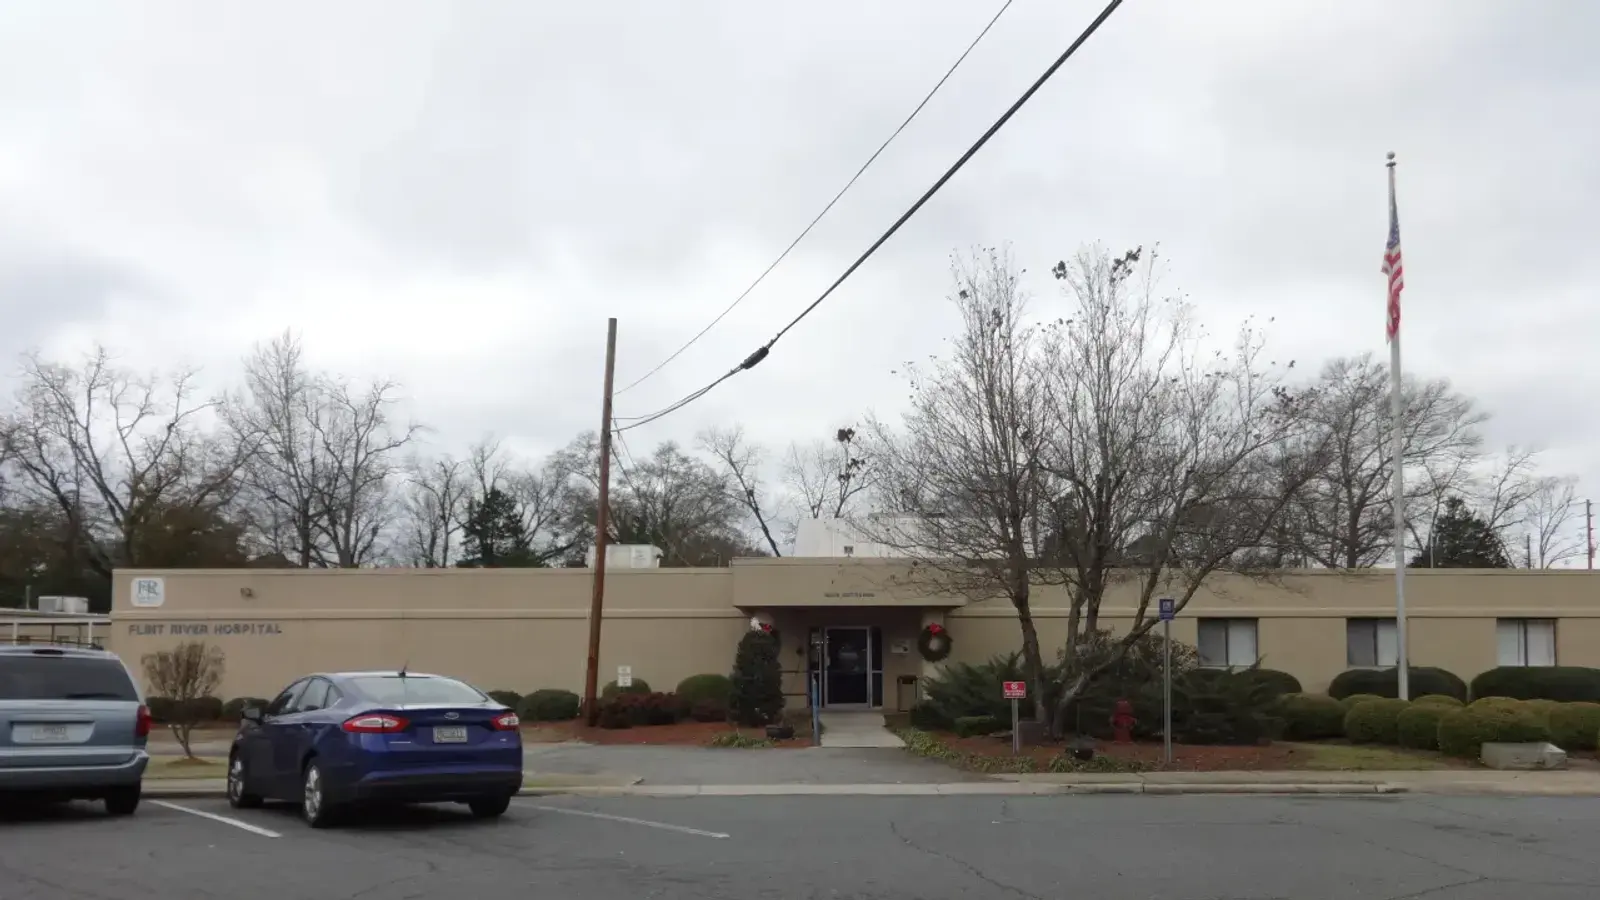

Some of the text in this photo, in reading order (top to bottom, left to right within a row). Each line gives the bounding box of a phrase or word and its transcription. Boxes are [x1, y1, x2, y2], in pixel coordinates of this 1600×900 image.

[128, 624, 283, 635] FLINT RIVER HOSPITAL
